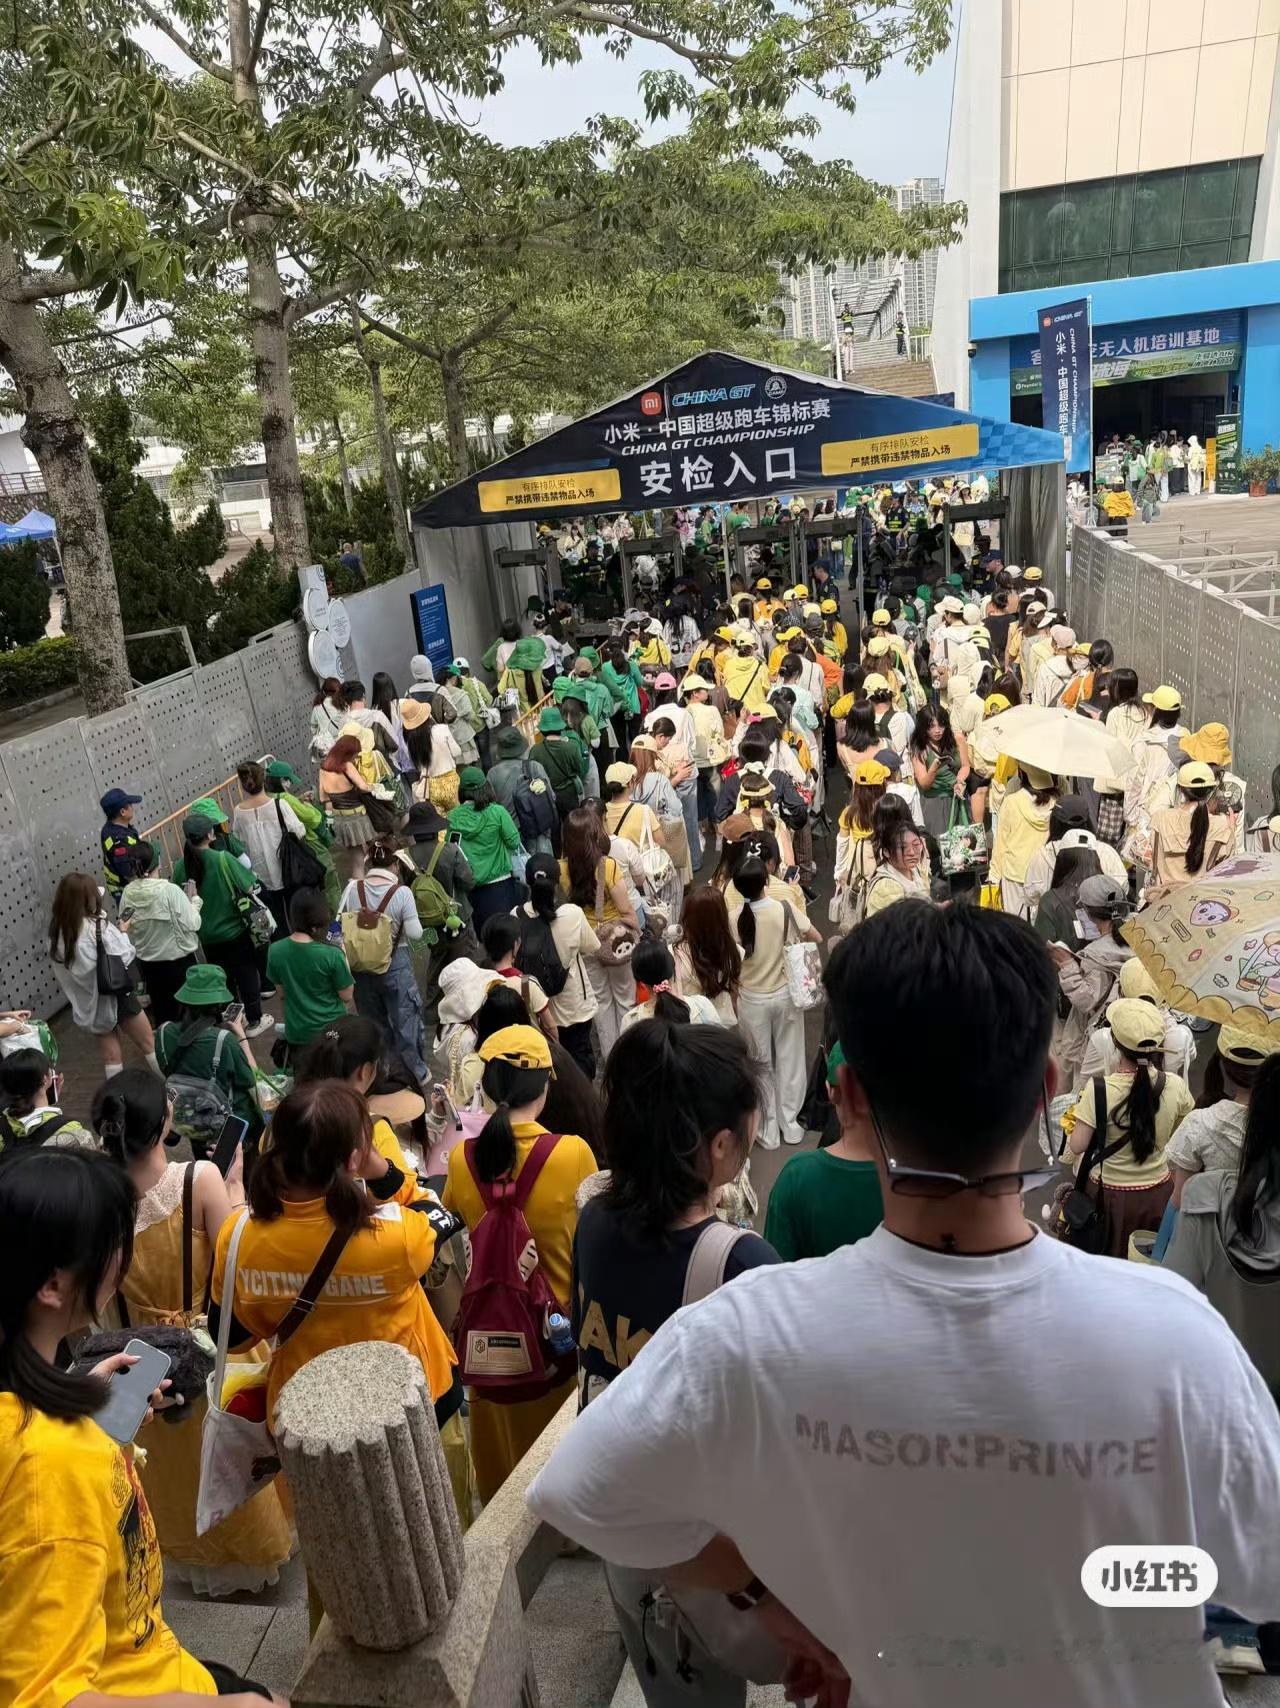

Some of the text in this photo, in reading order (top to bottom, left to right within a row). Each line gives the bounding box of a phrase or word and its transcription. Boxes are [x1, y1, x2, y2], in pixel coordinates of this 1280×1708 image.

[672, 384, 756, 406] CHINA GT
[621, 424, 815, 456] CHINA GT CHAMPIONSHIP
[850, 444, 951, 468] 严禁携带违禁物品入场
[640, 447, 796, 497] 安检入口
[505, 488, 595, 505] 严禁携带违禁物品入场
[795, 1412, 1157, 1479] MASONPRINCE
